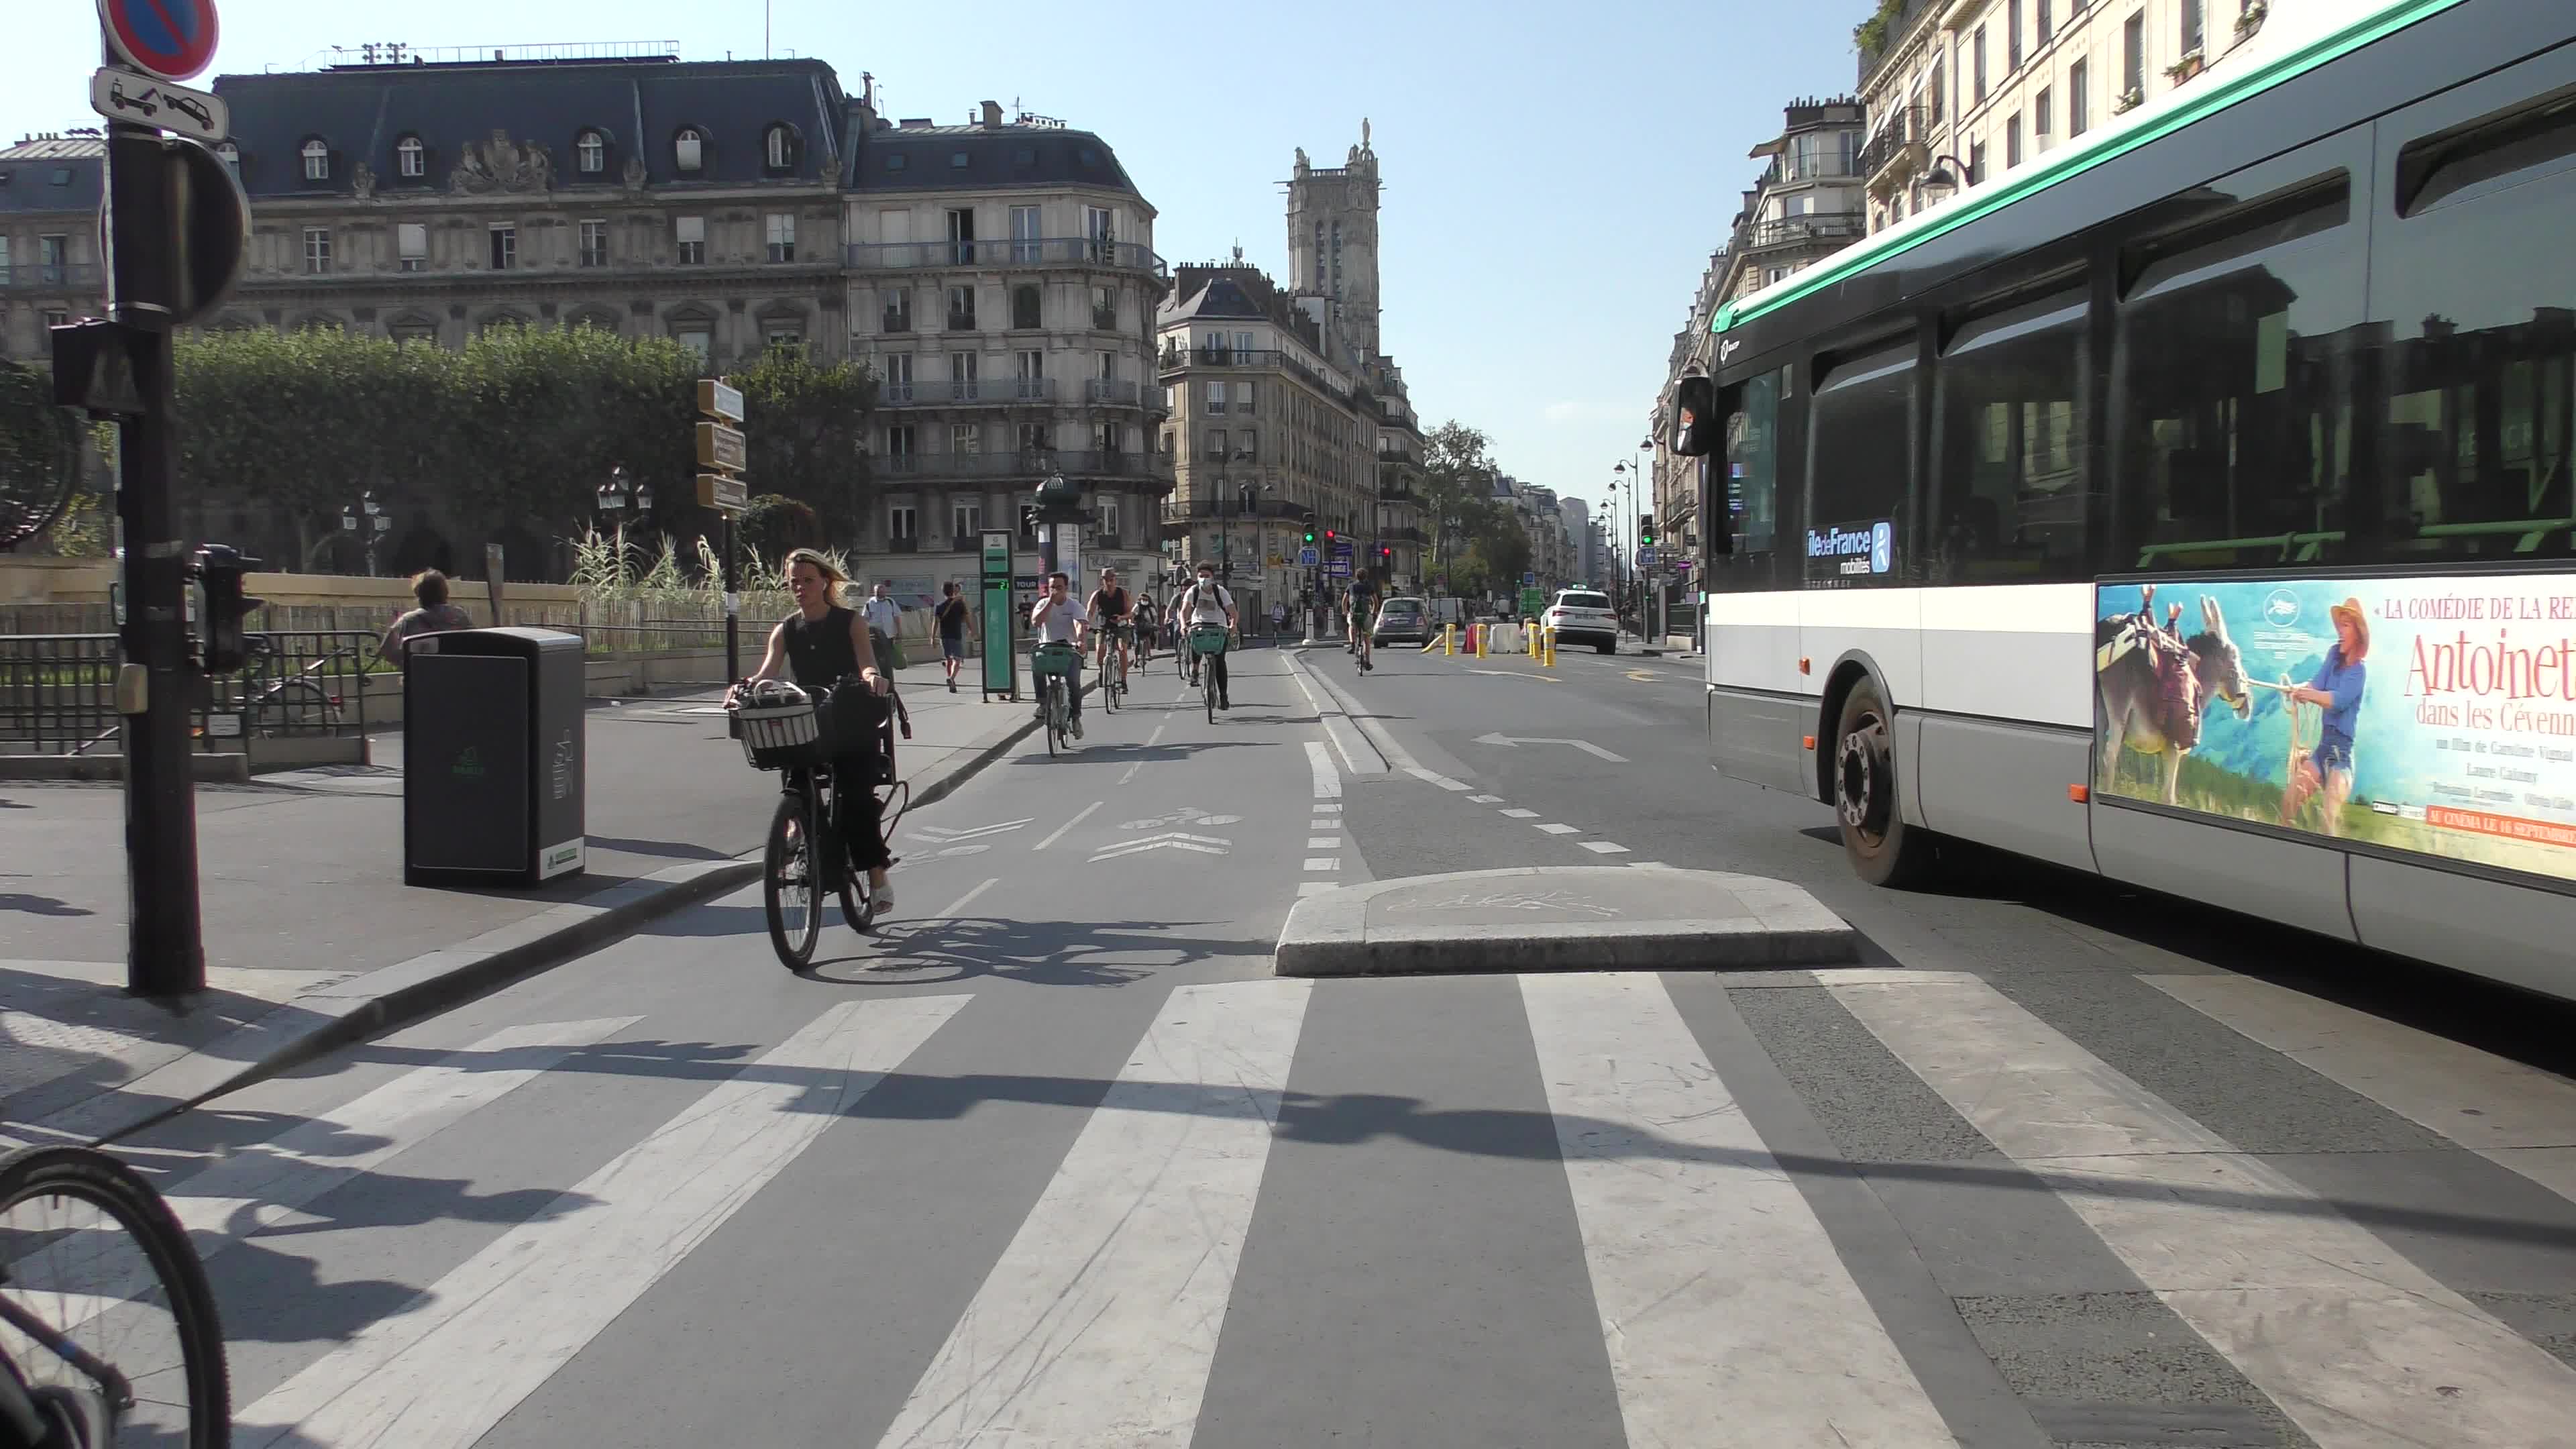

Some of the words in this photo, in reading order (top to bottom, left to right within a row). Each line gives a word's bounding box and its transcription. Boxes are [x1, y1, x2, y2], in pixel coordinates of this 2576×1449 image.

[1840, 556, 1870, 575] mobilités
[2384, 598, 2404, 619] LA
[2408, 592, 2484, 619] COMÉDIE
[2490, 597, 2513, 619] DE
[2519, 597, 2542, 619] LA
[2548, 596, 2576, 619] RE
[2404, 628, 2576, 701] Antoinet
[2416, 697, 2459, 727] dans
[2465, 700, 2493, 730] les
[2475, 741, 2487, 753] de
[2444, 811, 2481, 829] CINÉMA
[2483, 817, 2498, 831] LE
